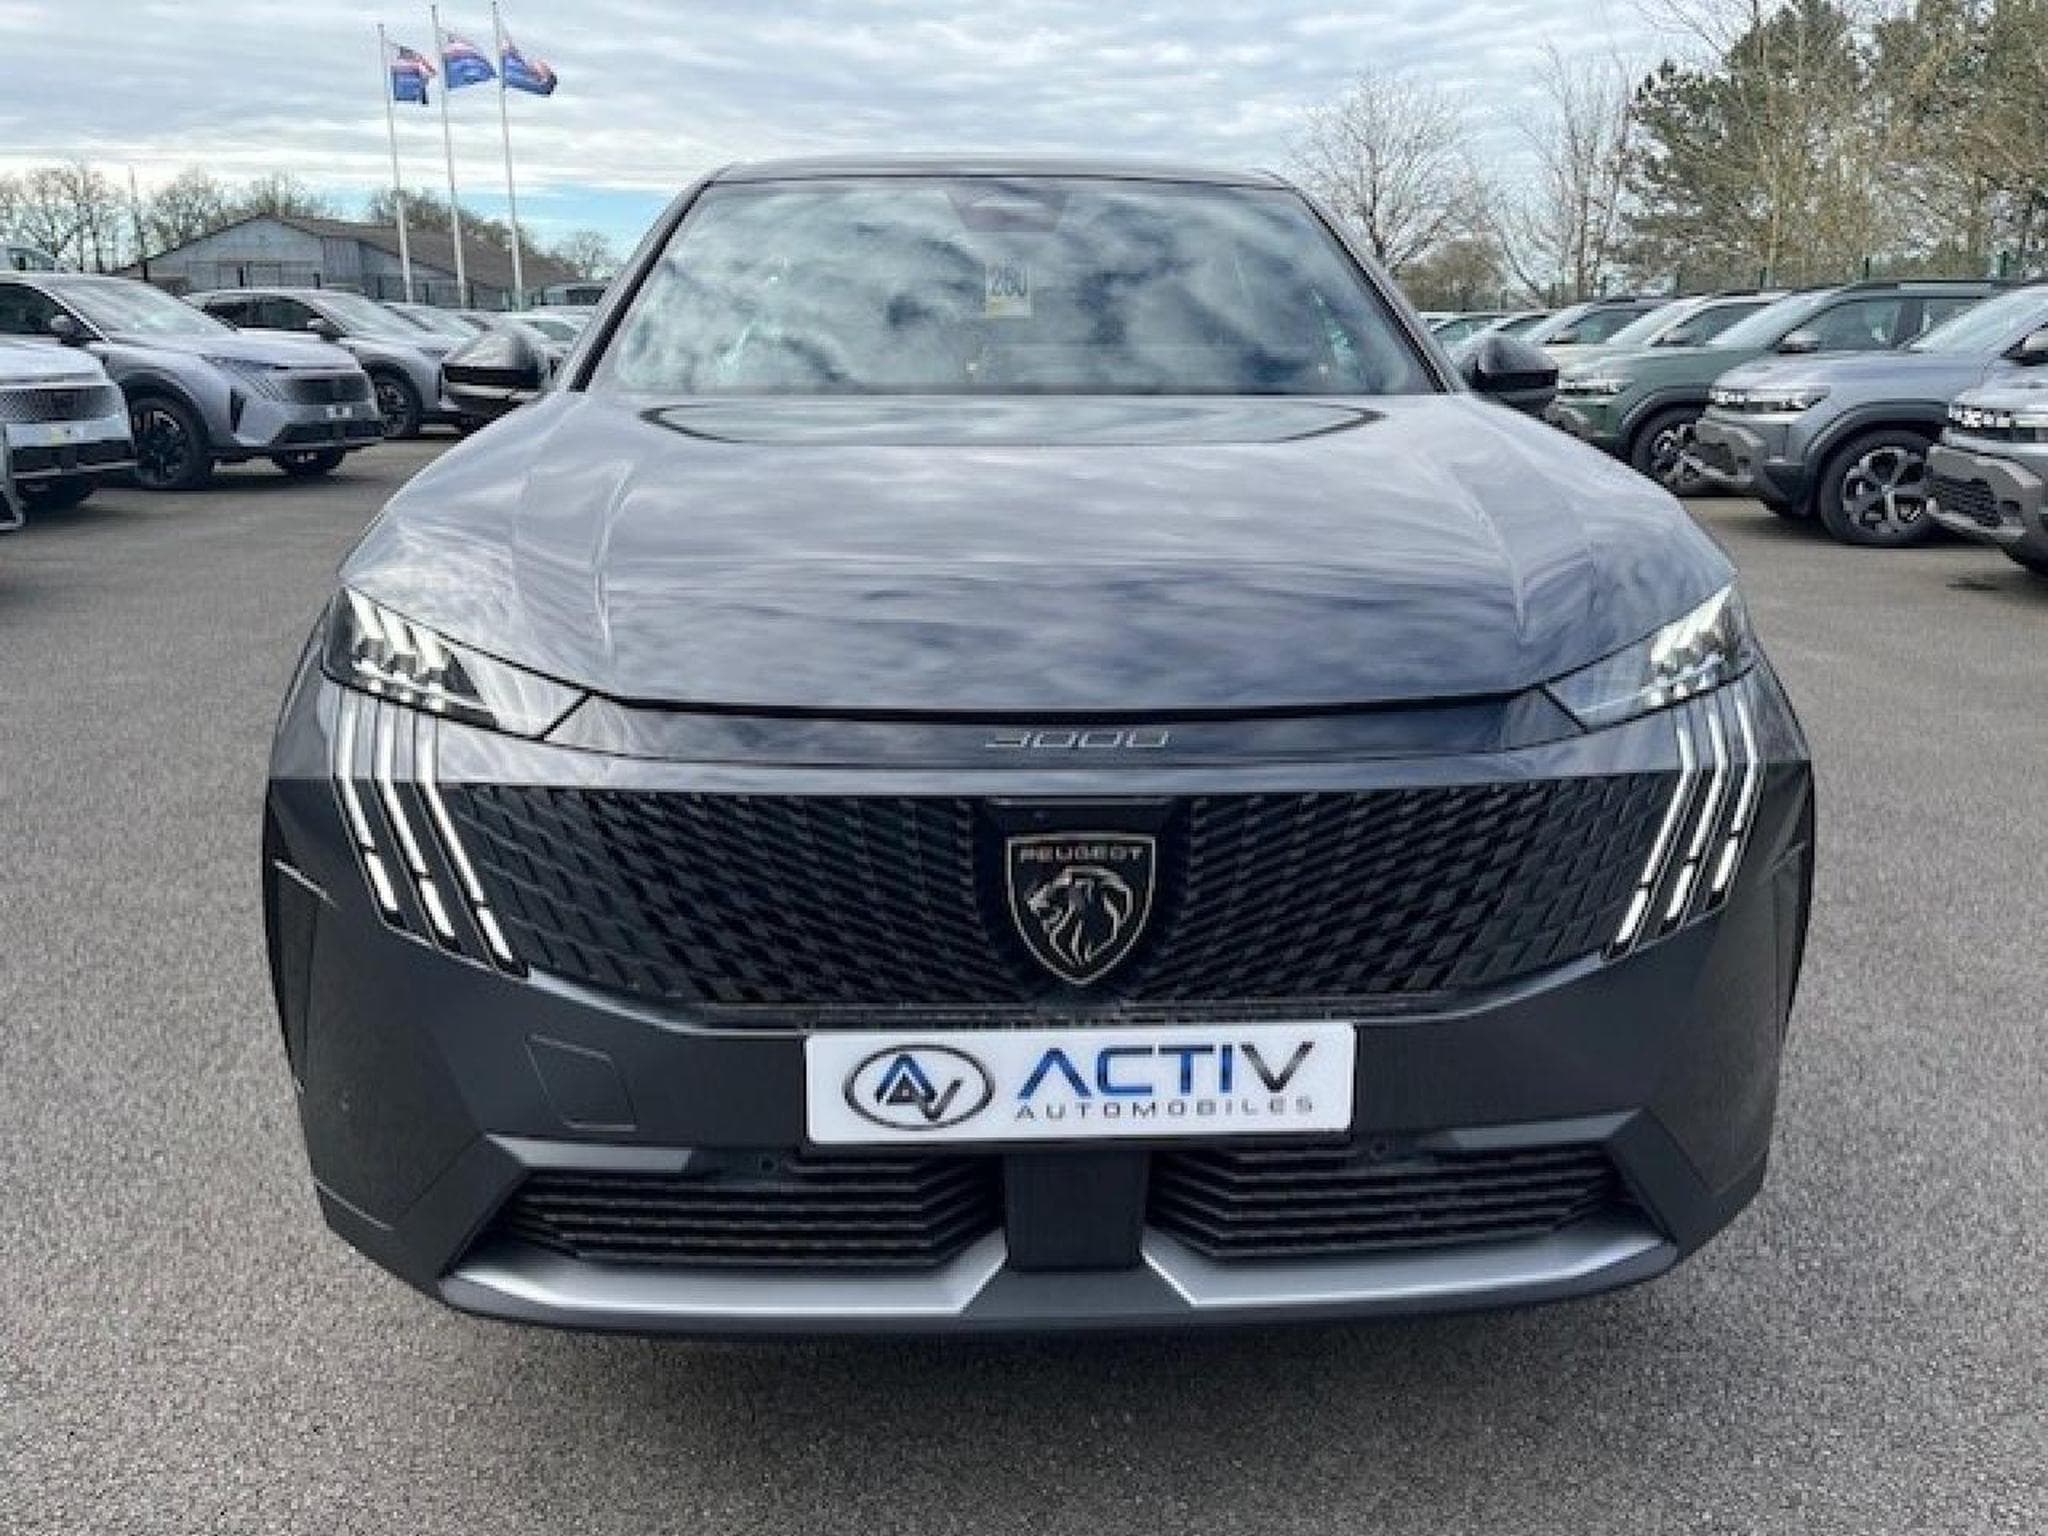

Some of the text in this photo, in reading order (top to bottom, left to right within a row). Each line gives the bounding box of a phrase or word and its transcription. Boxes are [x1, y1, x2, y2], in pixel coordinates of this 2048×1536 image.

[1020, 845, 1143, 864] PEUGEOT
[1017, 1041, 1316, 1100] ACTIV
[1014, 1096, 1315, 1121] AUTOMOBILES
